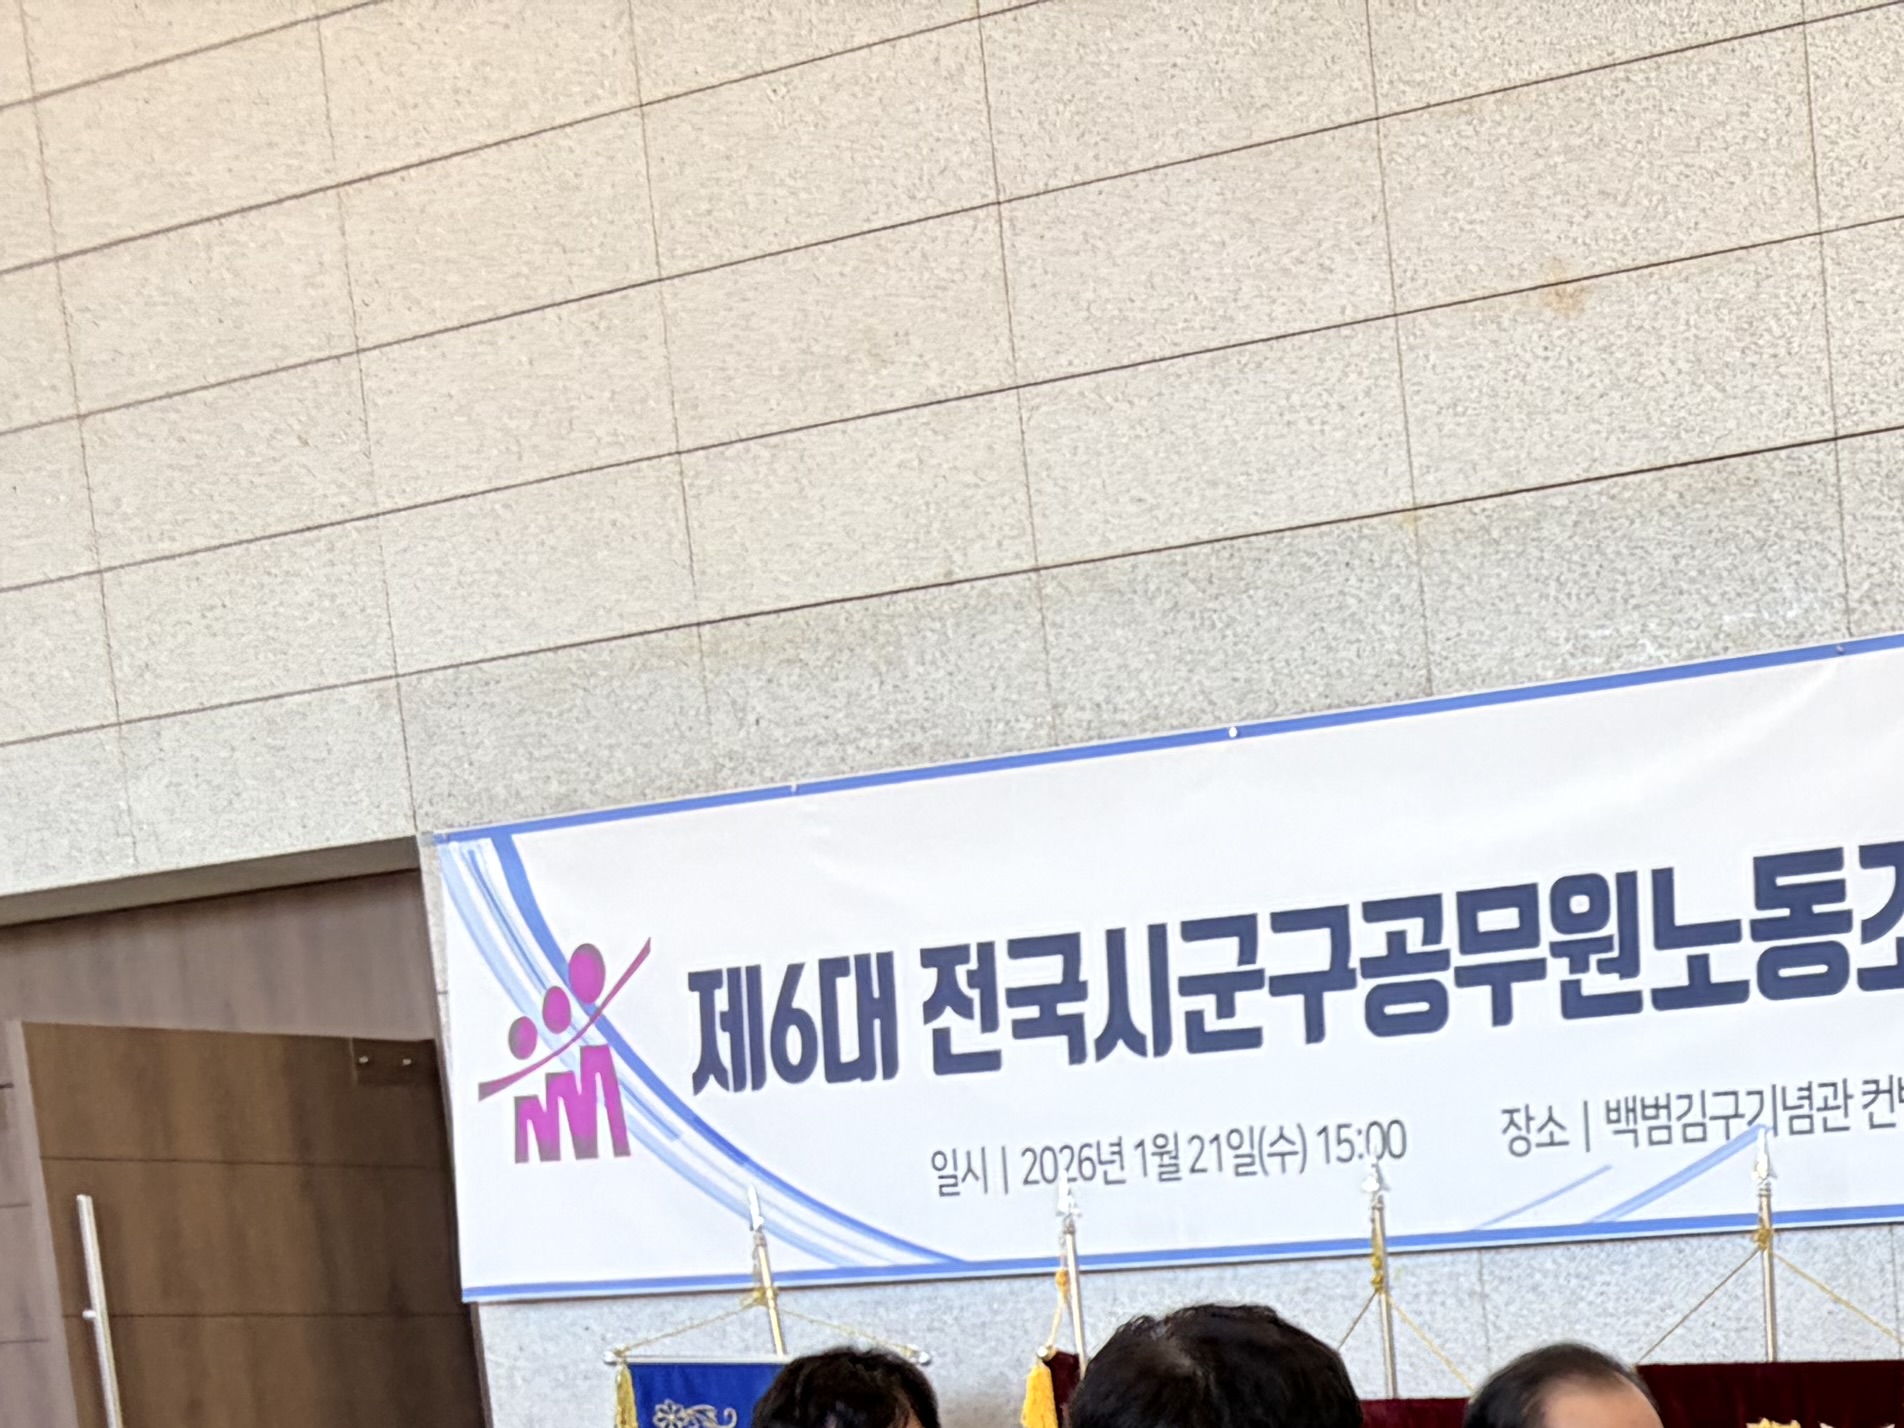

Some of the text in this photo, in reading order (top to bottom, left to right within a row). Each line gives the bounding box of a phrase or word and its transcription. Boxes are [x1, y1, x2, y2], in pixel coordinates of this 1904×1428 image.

[687, 950, 899, 1095] 제6대
[931, 1145, 989, 1197] 일시
[1020, 1136, 1127, 1186] 2026년
[1133, 1130, 1183, 1183] 1월
[1188, 1121, 1308, 1177] 21일(수)
[1316, 1118, 1408, 1164] 15:00
[1501, 1103, 1571, 1158] 장소
[1604, 1076, 1854, 1149] 백범김구기념관
